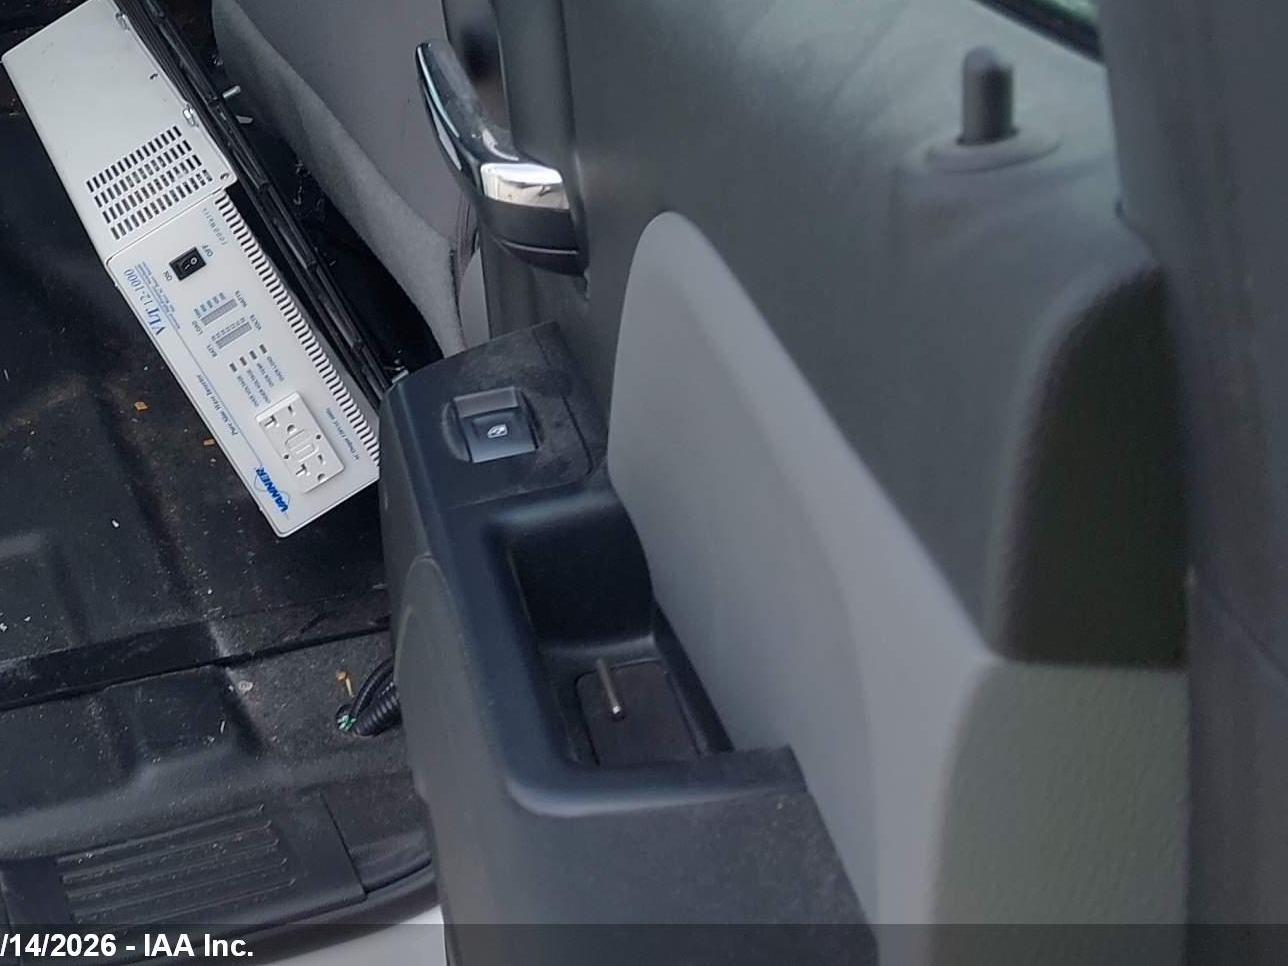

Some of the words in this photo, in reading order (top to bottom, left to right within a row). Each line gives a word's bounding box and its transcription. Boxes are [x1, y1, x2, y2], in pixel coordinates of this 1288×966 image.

[202, 243, 213, 257] OFF
[163, 270, 173, 281] ON
[124, 268, 153, 306] 12-1000
[235, 290, 247, 308] WATTS
[192, 320, 203, 335] LOAD
[250, 314, 262, 330] VOLTS
[196, 374, 212, 396] Inverter
[256, 466, 288, 513] VANNER
